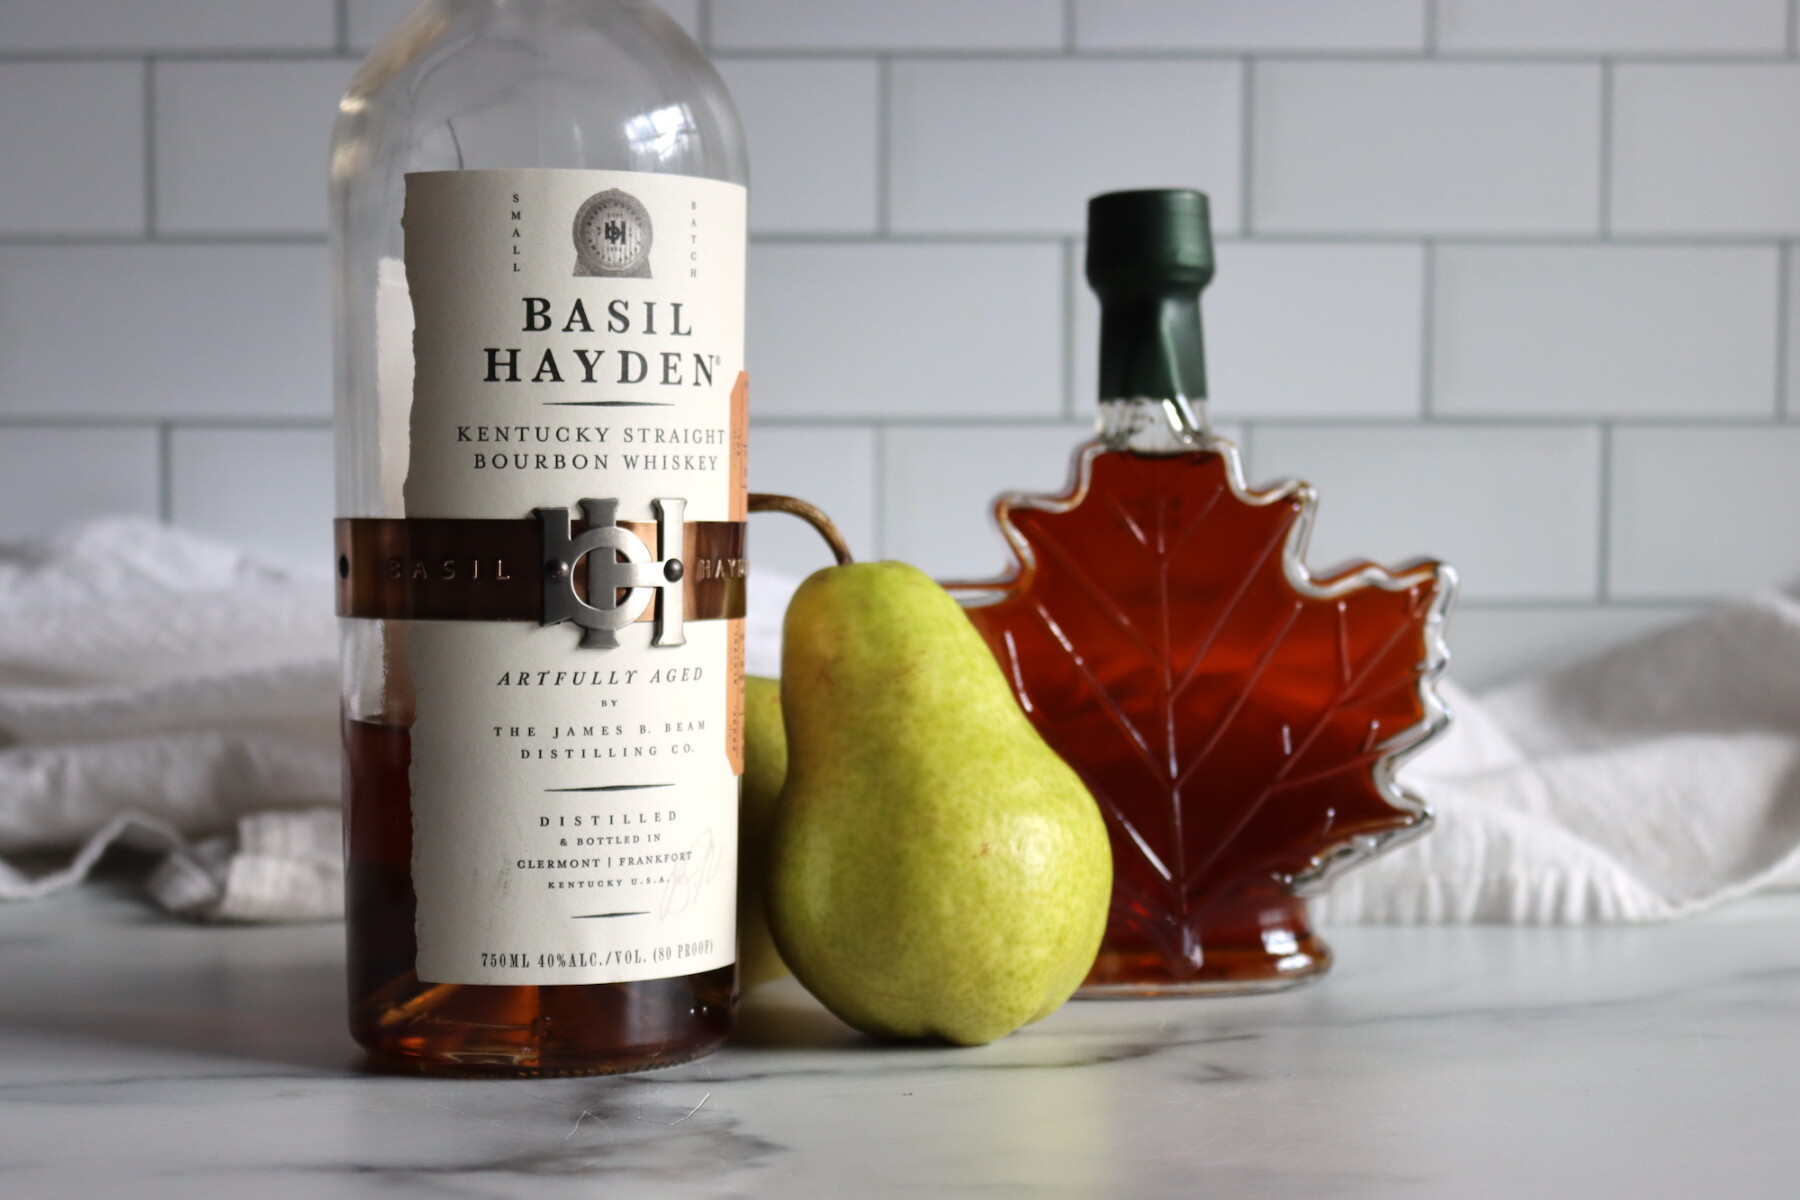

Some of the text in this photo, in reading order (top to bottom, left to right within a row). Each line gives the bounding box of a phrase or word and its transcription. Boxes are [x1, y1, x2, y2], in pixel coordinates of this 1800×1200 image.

[511, 194, 521, 272] SMALL
[689, 201, 697, 278] BATCH
[522, 297, 691, 336] BASIL
[456, 426, 725, 445] KENTUCKY STRAIGHT
[473, 453, 718, 471] BOURBON WHISKEY
[389, 559, 511, 580] BASIL
[496, 666, 703, 687] ARTFULLY AGED
[600, 699, 618, 708] BY
[493, 719, 706, 740] THE JAMES B. BEAM
[520, 743, 694, 760] DISTILLING CO.
[539, 810, 677, 828] DISTILLED
[559, 833, 661, 847] & BOTTLED IN
[516, 858, 601, 870] CLERMONT
[618, 850, 693, 867] FRANKFORT
[547, 875, 671, 890] KENTUCKY U.S.A.
[481, 952, 530, 969] 750ML
[652, 945, 672, 964] (80
[677, 938, 714, 960] PROOF)
